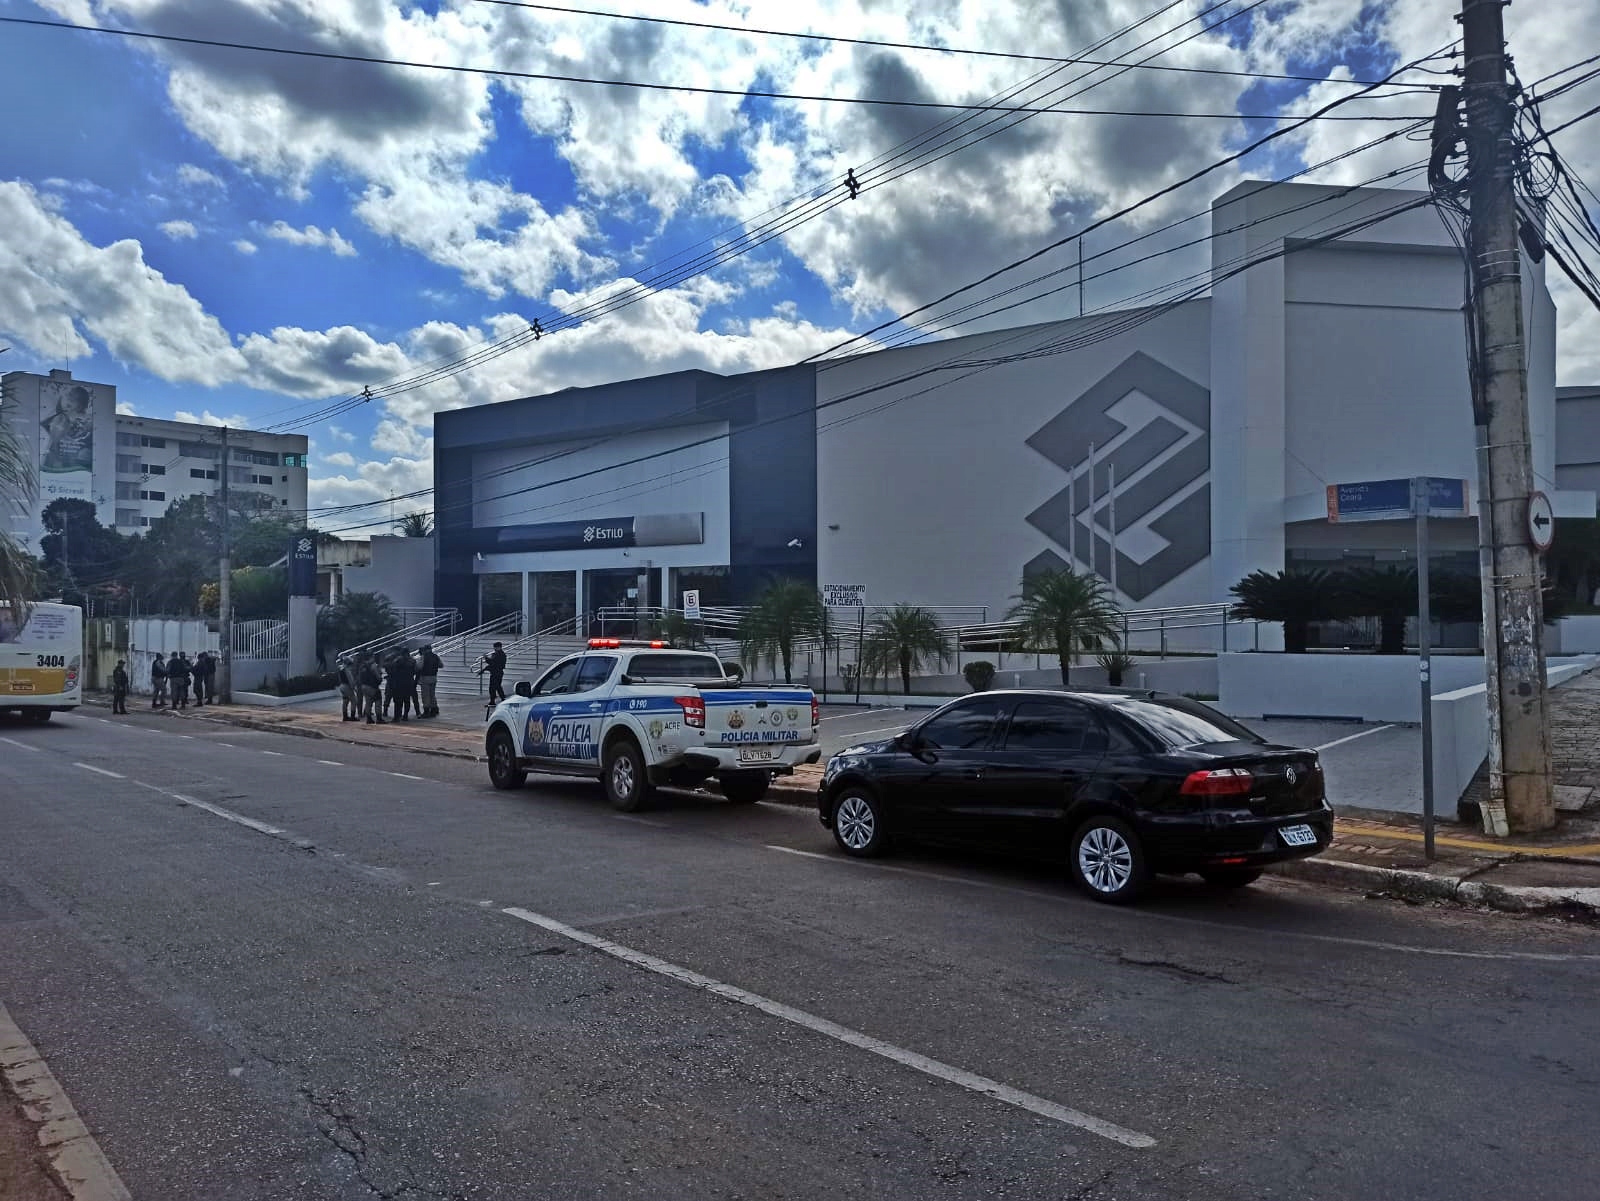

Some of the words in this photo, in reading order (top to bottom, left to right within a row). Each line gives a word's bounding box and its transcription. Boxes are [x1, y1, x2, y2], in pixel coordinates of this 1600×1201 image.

[37, 655, 65, 667] 3404
[635, 699, 648, 709] 190
[664, 721, 681, 730] ACRE
[550, 721, 592, 743] POLÍCIA
[721, 731, 759, 742] POLÍCIA
[762, 730, 798, 740] MILITAR
[549, 744, 577, 756] MILITAR
